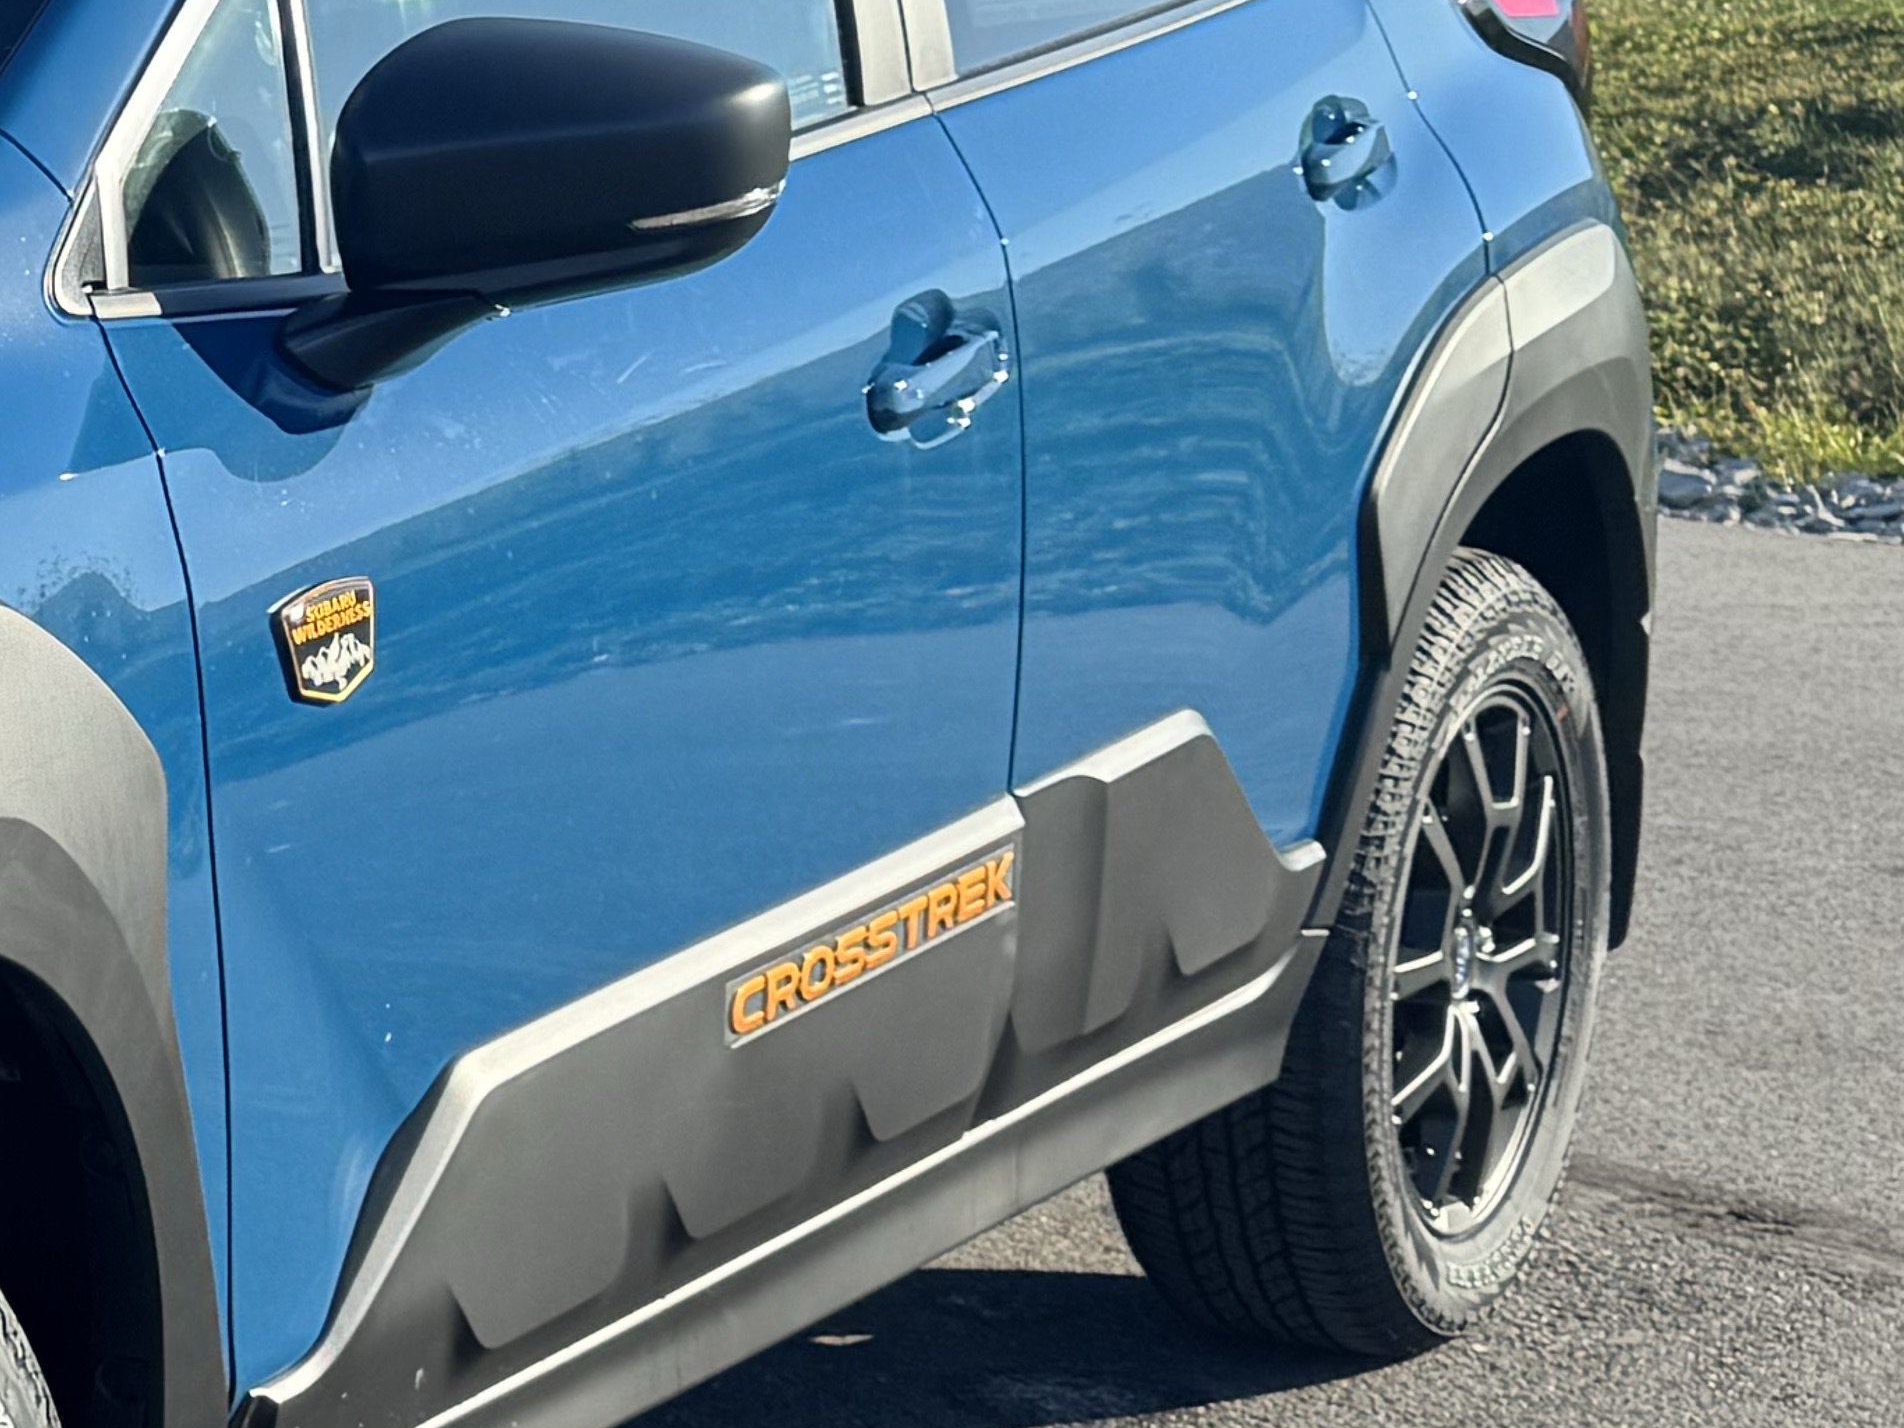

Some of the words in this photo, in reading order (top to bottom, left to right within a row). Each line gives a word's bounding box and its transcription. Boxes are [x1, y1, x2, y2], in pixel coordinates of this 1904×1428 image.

[292, 600, 373, 645] WILDERNESS
[305, 590, 356, 622] SUBARU
[730, 850, 1015, 1035] CROSSTREK
